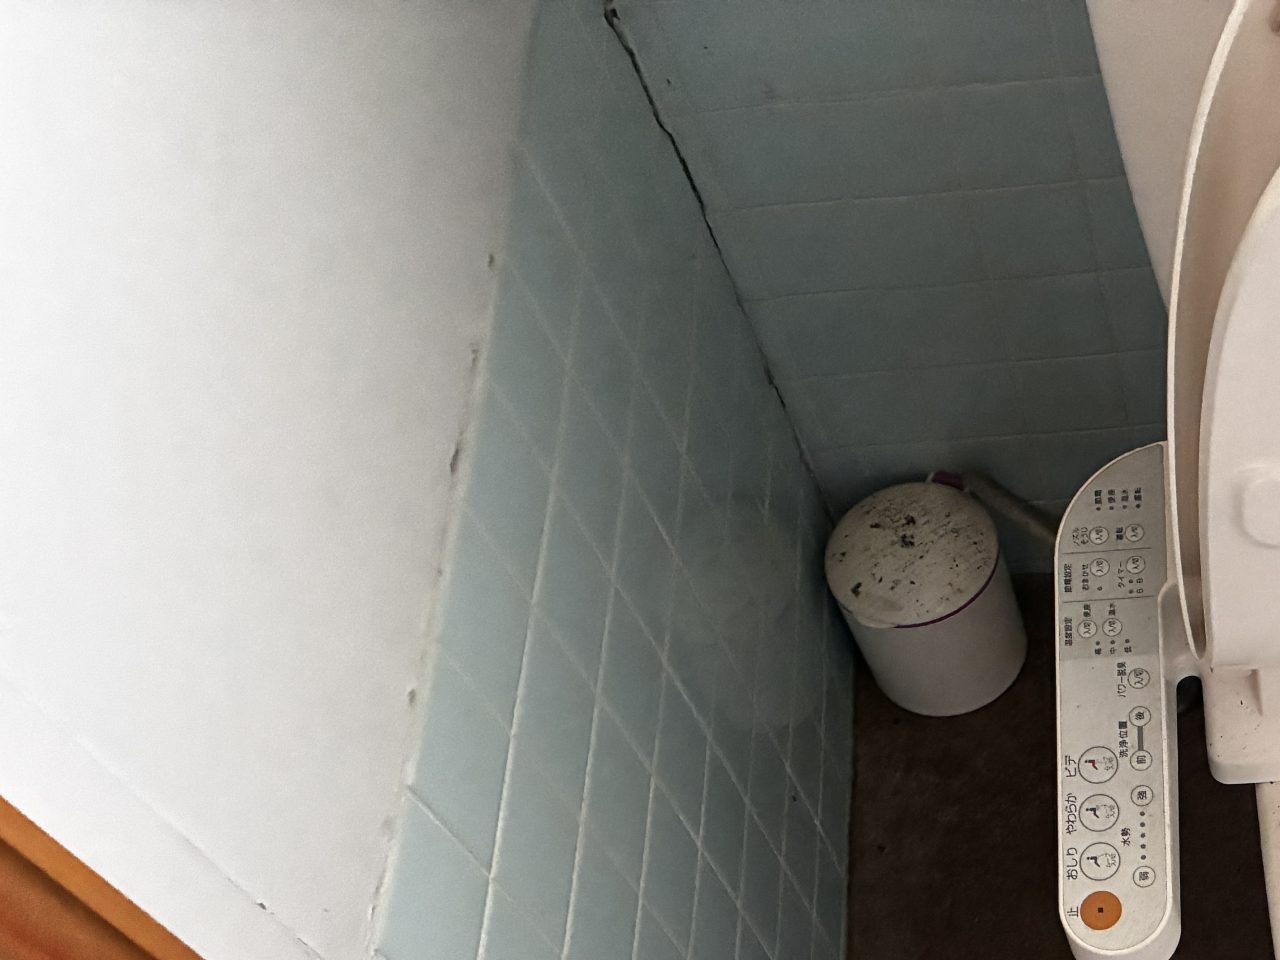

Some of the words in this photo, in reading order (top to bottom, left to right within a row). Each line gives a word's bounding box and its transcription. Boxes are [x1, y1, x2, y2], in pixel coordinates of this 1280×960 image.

[1117, 562, 1125, 588] タイマー
[1119, 720, 1129, 758] 洗浄位置
[1065, 755, 1077, 777] ビデ
[1065, 792, 1077, 835] やわらか
[1121, 827, 1131, 847] 水勢
[1066, 847, 1078, 880] おしり
[1067, 905, 1079, 917] 止
